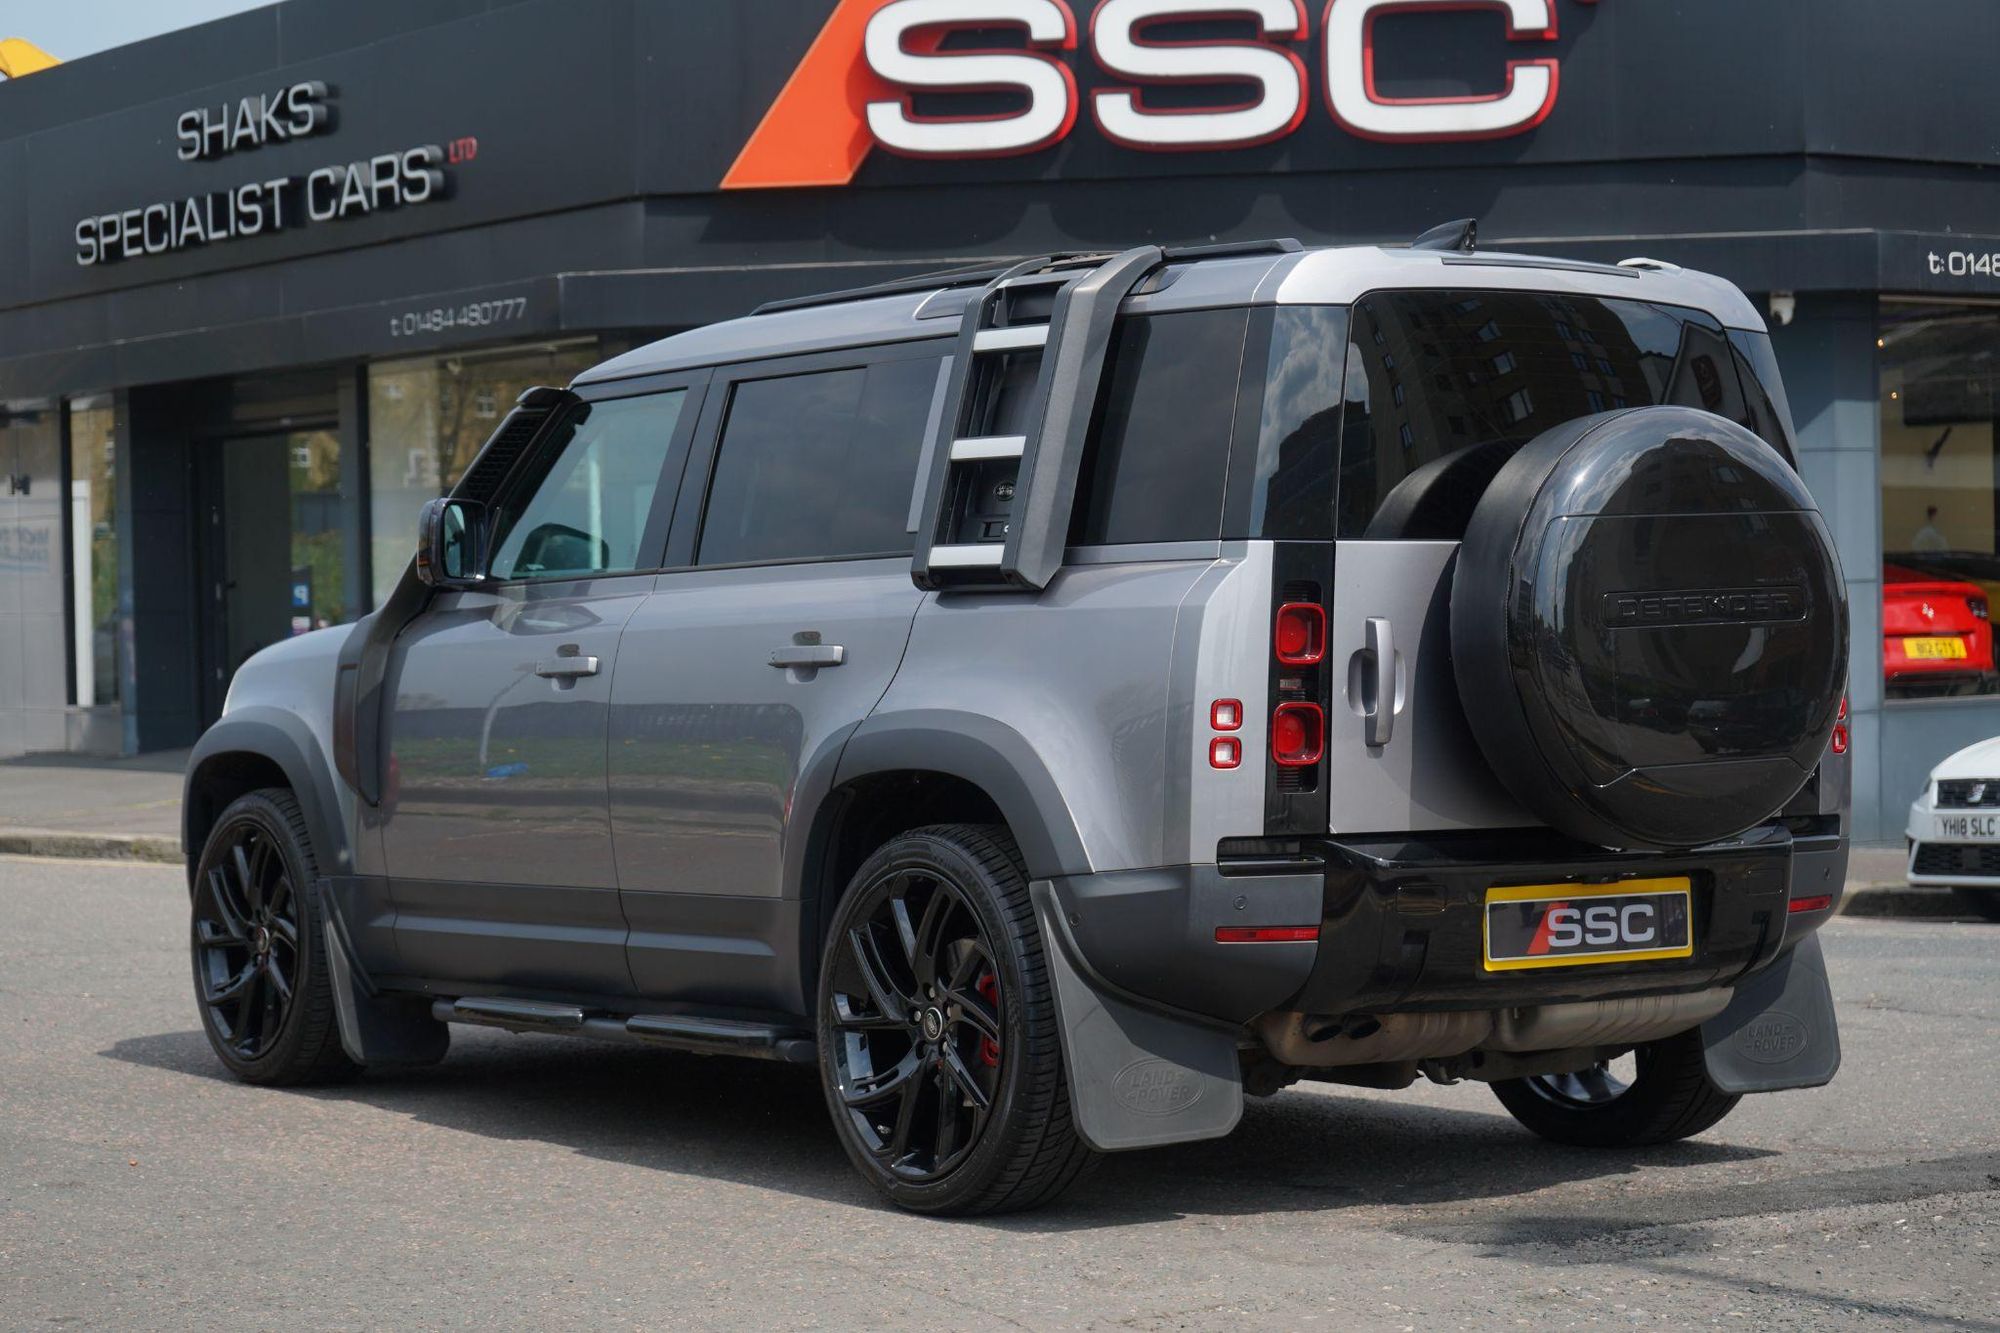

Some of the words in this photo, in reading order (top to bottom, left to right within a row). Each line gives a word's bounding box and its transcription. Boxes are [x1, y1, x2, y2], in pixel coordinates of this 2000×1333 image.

[865, 0, 1557, 153] SSC
[177, 81, 318, 161] SHAKS
[75, 177, 289, 265] SPECIALIST
[307, 146, 434, 221] CARS
[448, 137, 477, 164] LTD
[1617, 593, 1790, 616] DEFENDER
[1970, 817, 1996, 836] SLC
[1547, 903, 1655, 948] SSC
[1748, 1023, 1780, 1039] LAND
[1754, 1035, 1796, 1053] ROVER
[1130, 1068, 1176, 1088] LAND
[1135, 1085, 1190, 1105] ROVER
